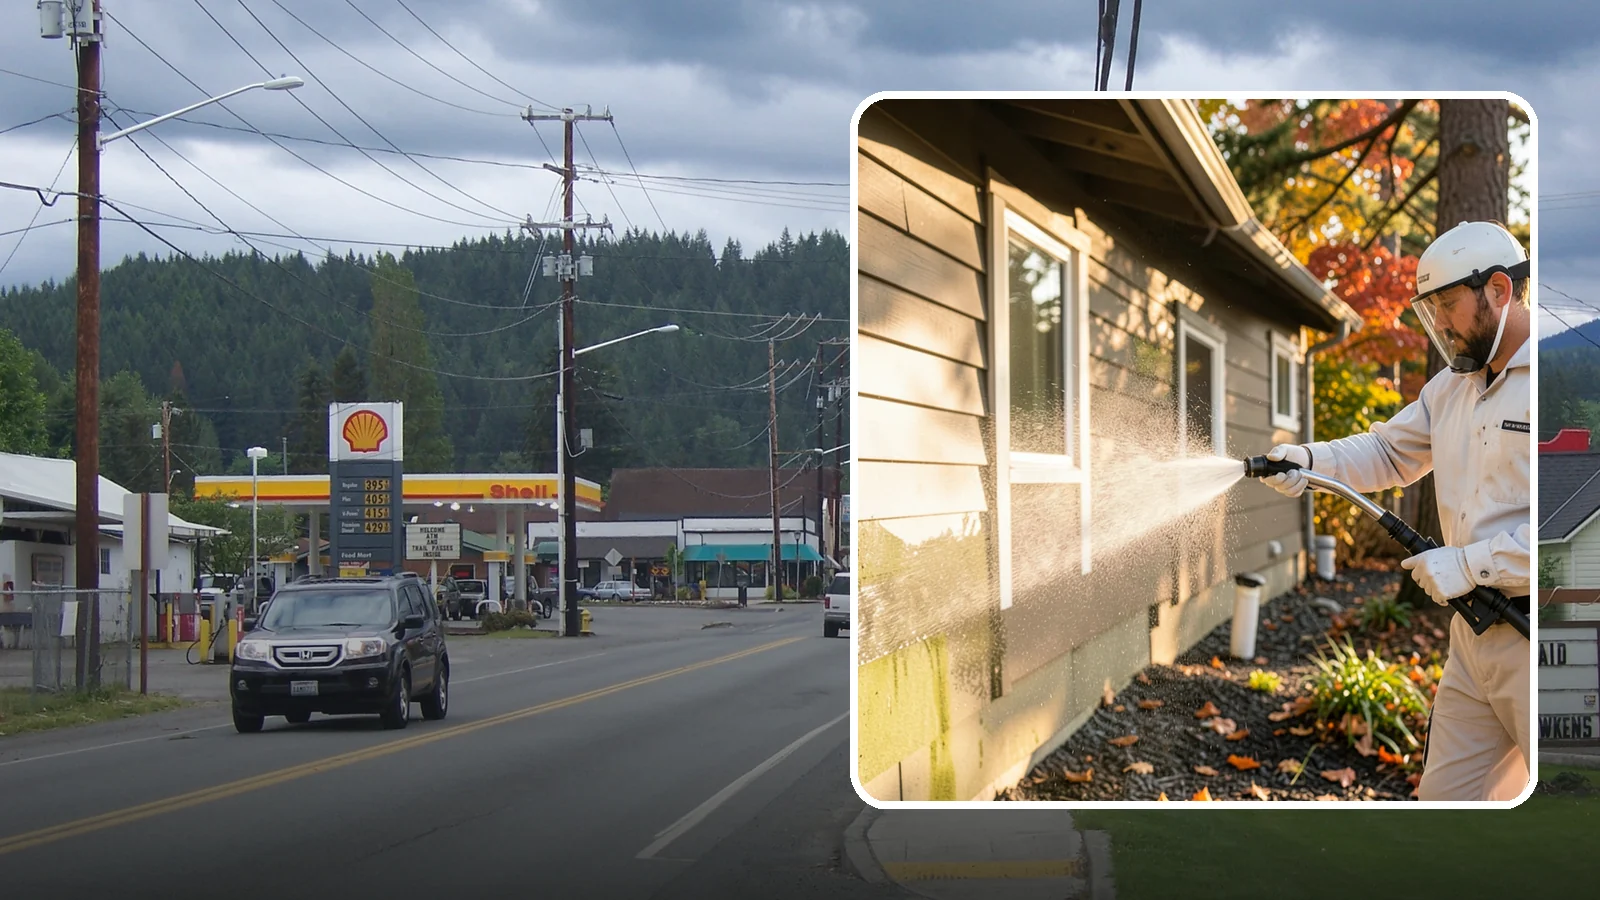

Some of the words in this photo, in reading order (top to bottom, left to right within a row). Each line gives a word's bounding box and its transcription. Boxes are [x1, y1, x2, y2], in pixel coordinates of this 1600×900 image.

[365, 480, 383, 490] 395
[490, 484, 547, 499] Shell
[365, 494, 383, 504] 405
[365, 508, 383, 518] 415
[365, 522, 383, 532] 429
